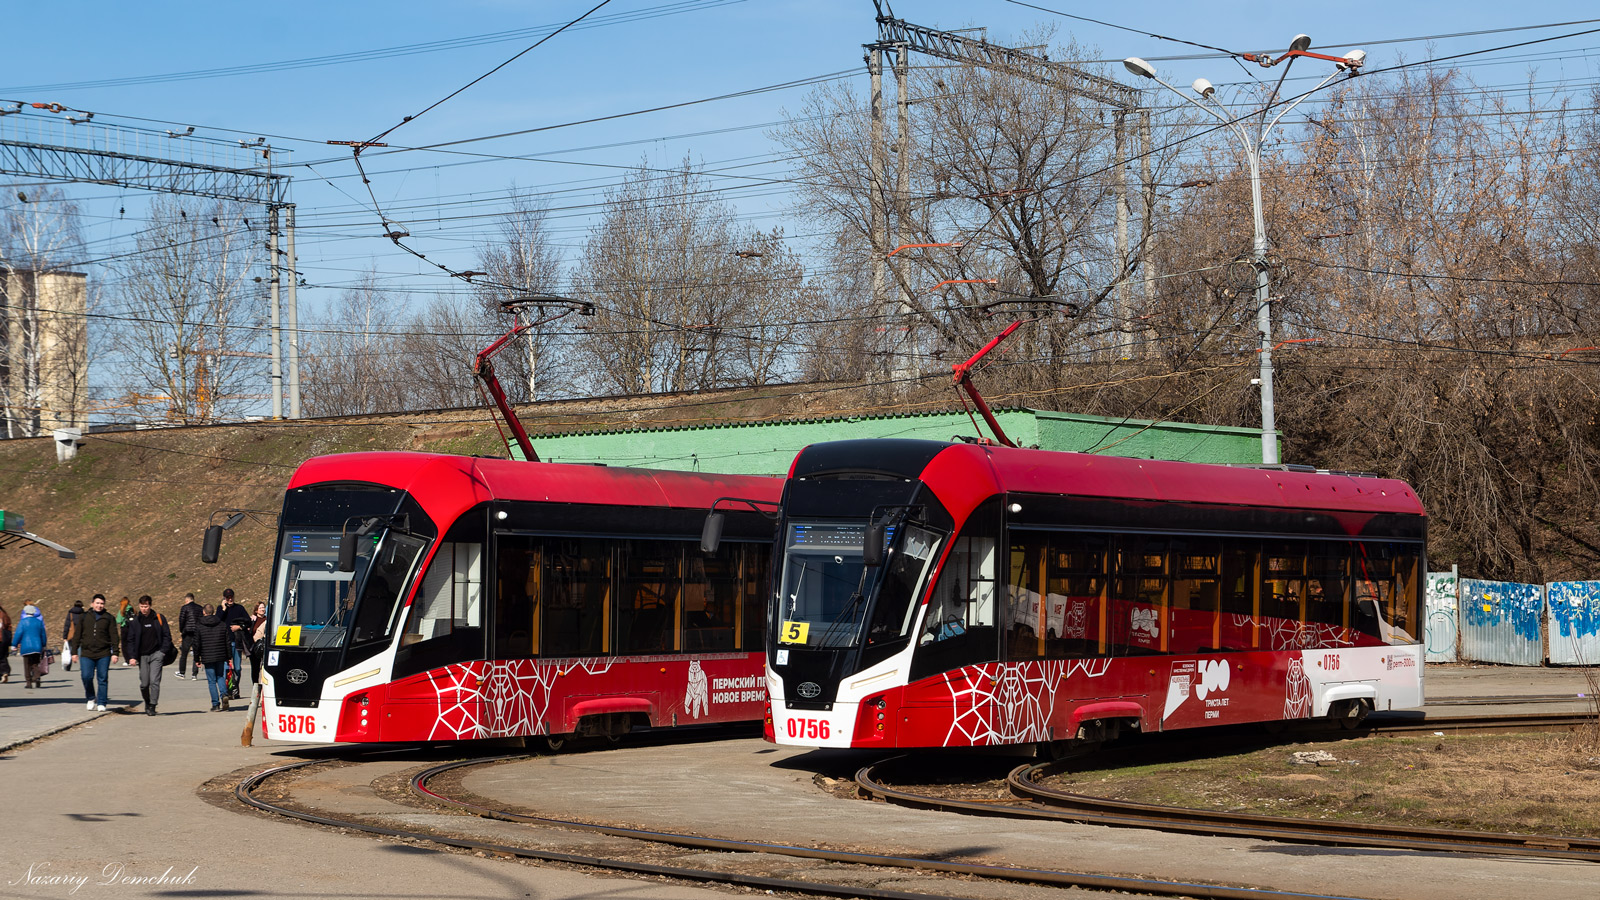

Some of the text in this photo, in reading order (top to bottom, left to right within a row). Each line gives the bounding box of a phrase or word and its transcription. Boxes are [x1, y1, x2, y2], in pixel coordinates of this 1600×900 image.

[282, 628, 292, 643] 4
[788, 623, 801, 640] 5
[1323, 654, 1340, 671] 0756
[712, 674, 756, 690] ПЕРМСКИЙ
[1195, 659, 1230, 701] 300
[712, 690, 766, 704] НОВОЕ ВРЕМЯ
[278, 714, 316, 735] 5876
[787, 717, 831, 740] 0756
